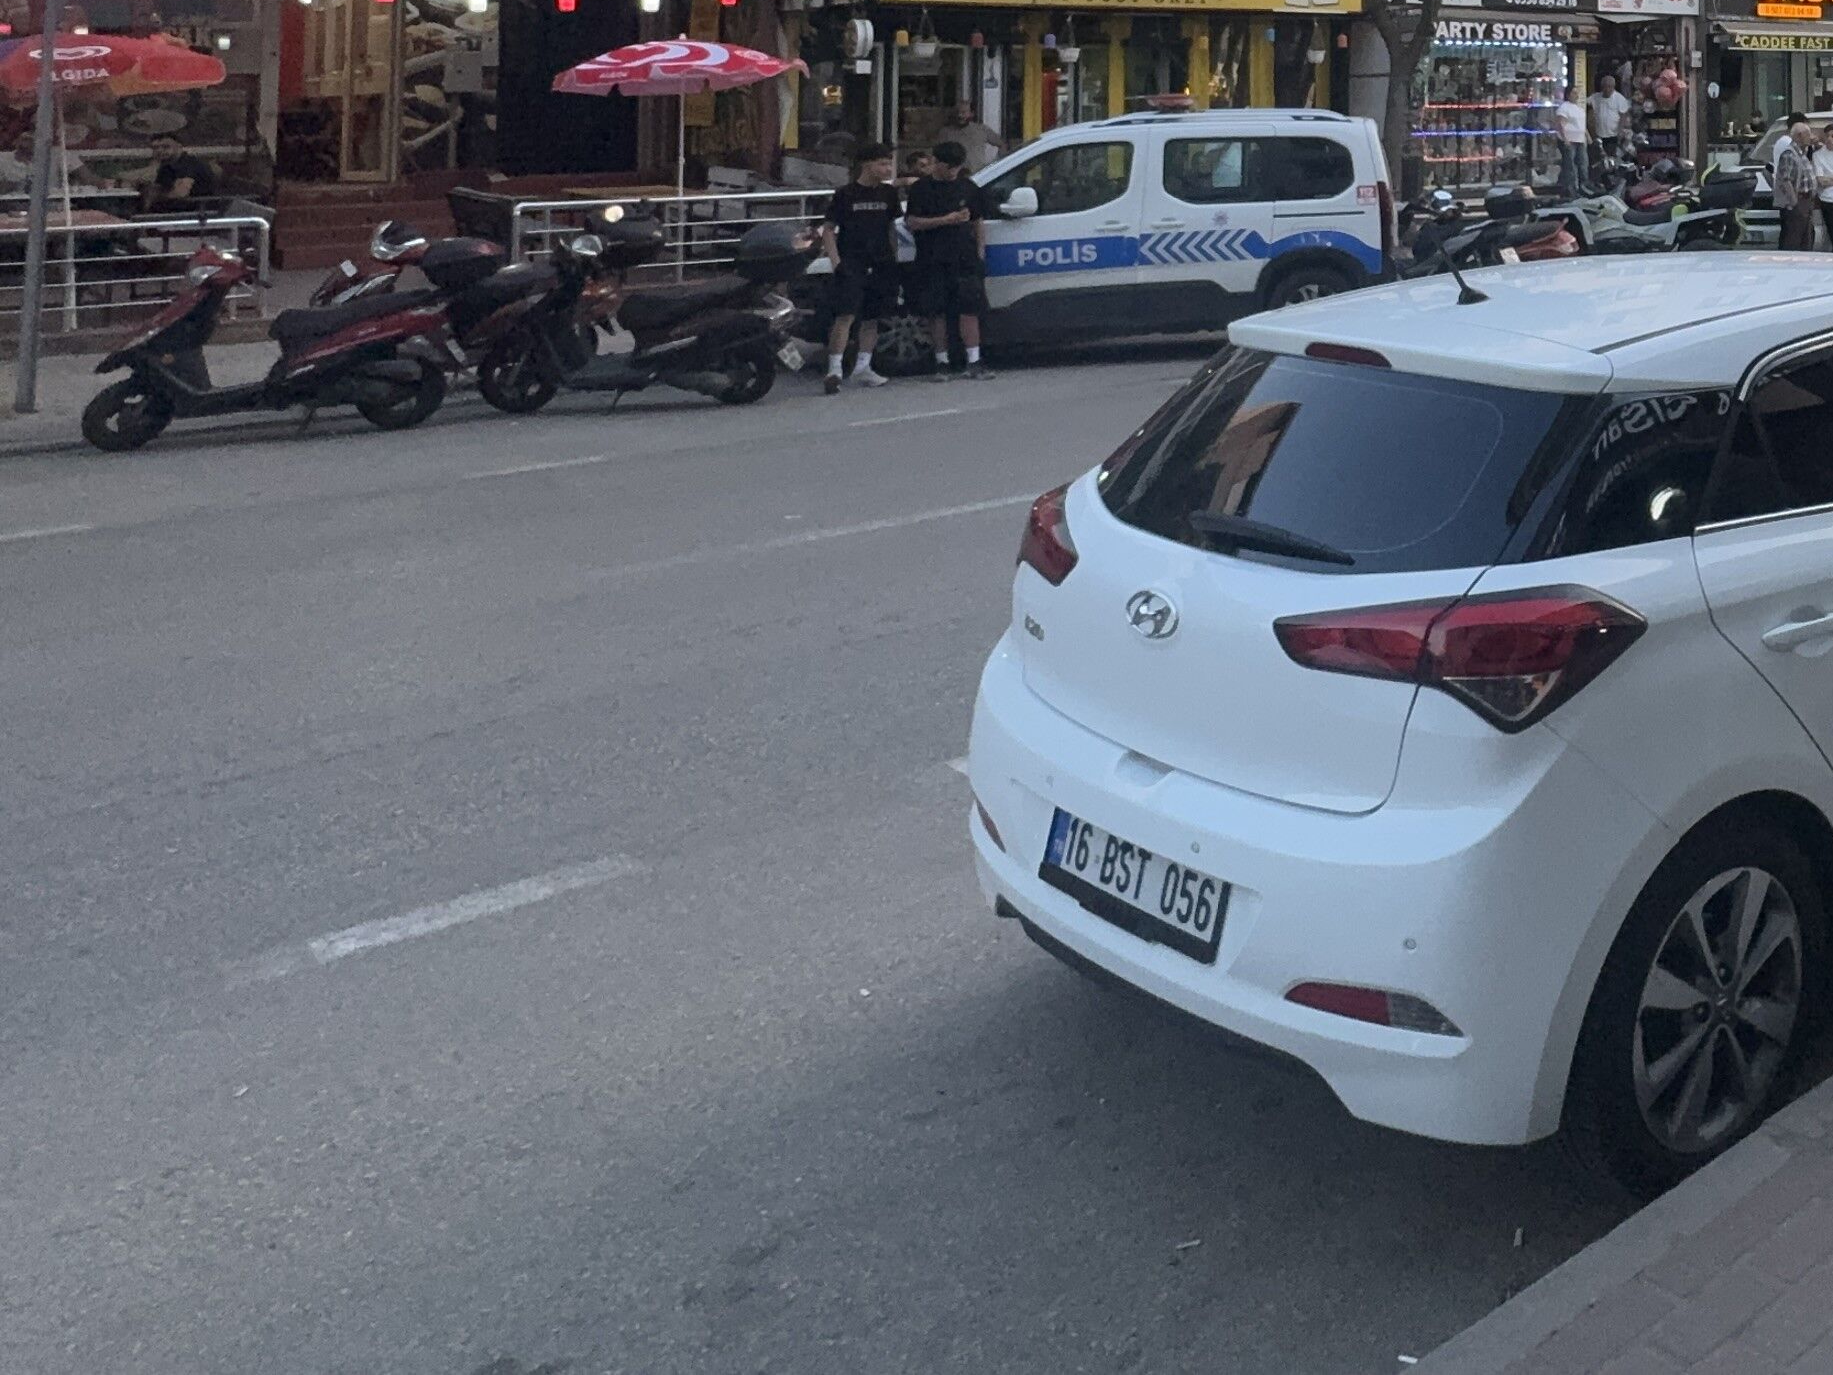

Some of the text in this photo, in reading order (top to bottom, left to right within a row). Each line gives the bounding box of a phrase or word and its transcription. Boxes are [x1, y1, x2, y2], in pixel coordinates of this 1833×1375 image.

[1434, 21, 1551, 41] ARTY STORE
[1739, 36, 1797, 50] CADDEE
[1800, 36, 1831, 50] FAST
[51, 67, 110, 82] LGIDA
[1017, 240, 1098, 266] POLİS
[1065, 817, 1216, 933] 16 BST 056
